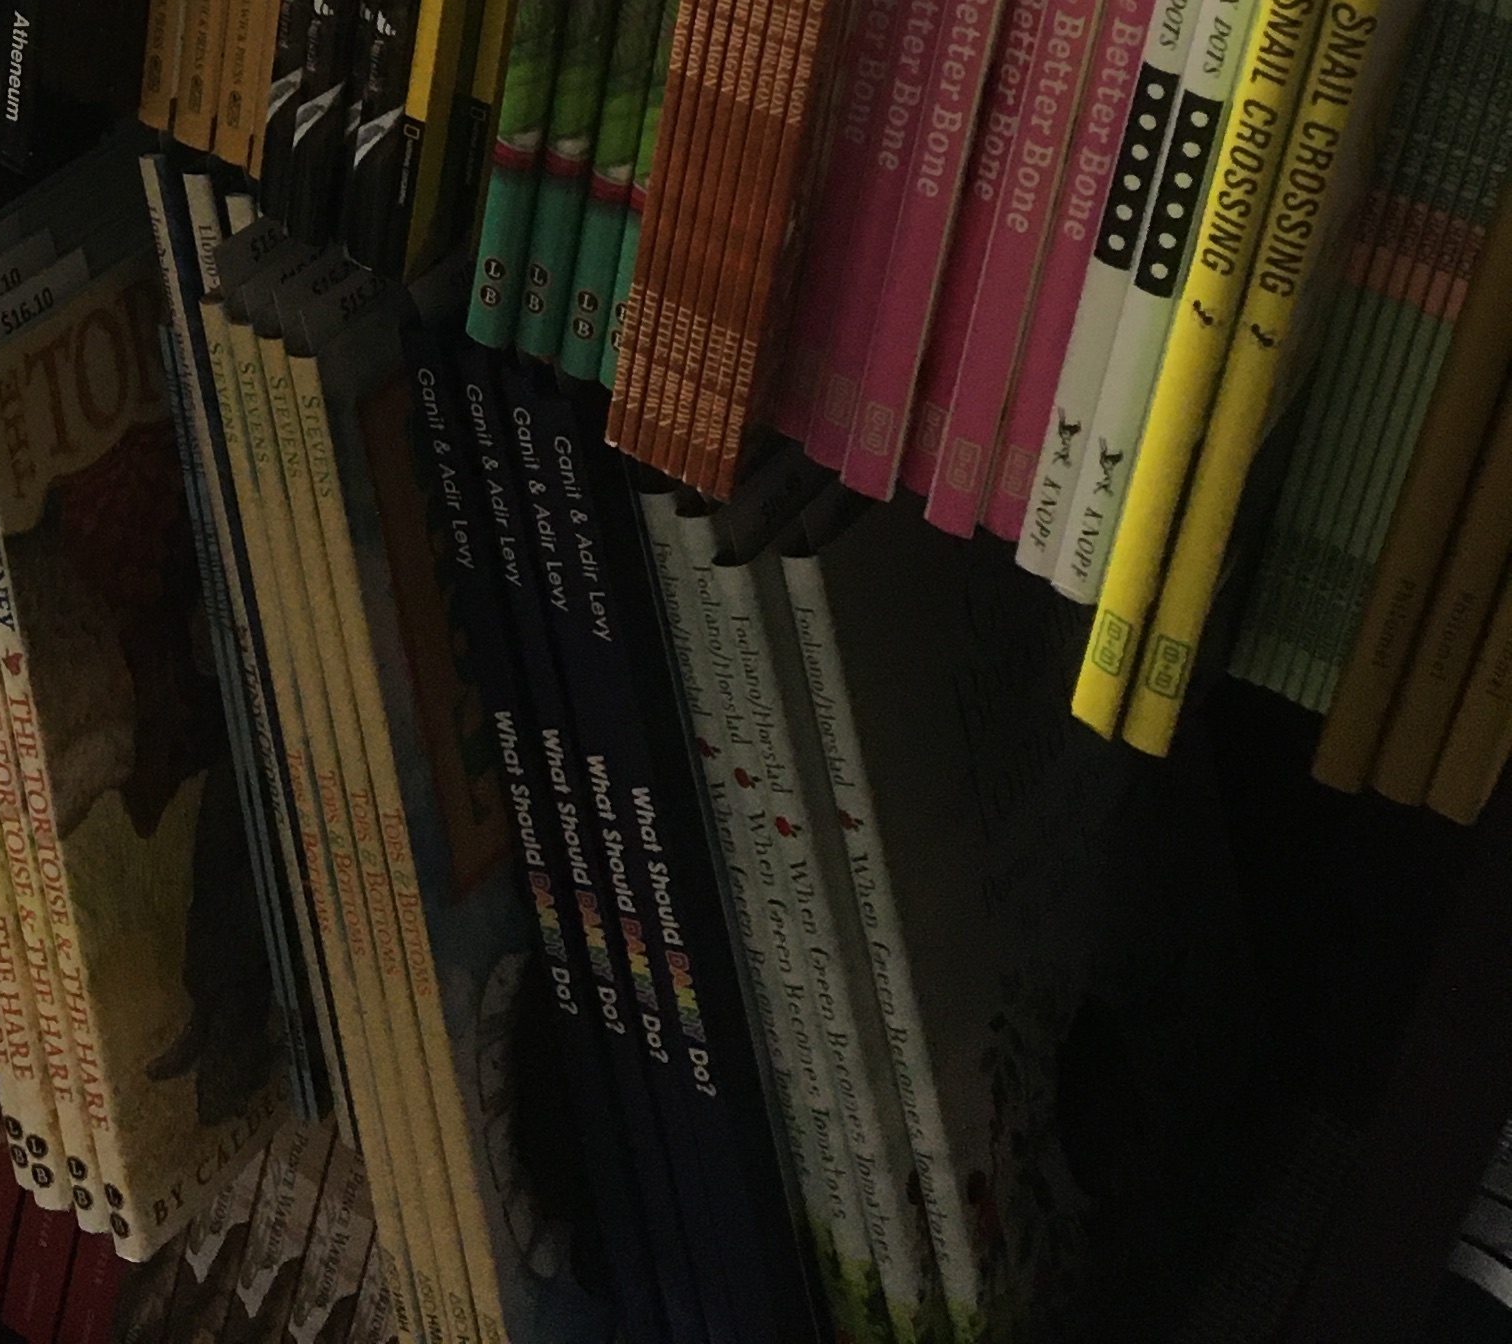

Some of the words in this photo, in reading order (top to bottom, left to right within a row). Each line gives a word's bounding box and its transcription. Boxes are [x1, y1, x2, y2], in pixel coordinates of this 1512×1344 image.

[4, 9, 31, 123] Atheneum
[1090, 16, 1144, 138] Better
[1159, 0, 1191, 54] DOTS
[1062, 138, 1112, 243] Bone
[1200, 95, 1278, 278] CROSSING
[0, 287, 55, 335] $16.10
[301, 395, 334, 499] STEVENS
[416, 367, 447, 432] Ganit
[438, 464, 464, 514] Adir
[1032, 473, 1060, 553] KNOPF
[449, 519, 476, 569] Levy
[30, 764, 72, 928] TORTOISE
[78, 1043, 112, 1133] HARE
[630, 786, 660, 848] What
[645, 854, 683, 949] Should
[687, 1038, 719, 1098] Do?
